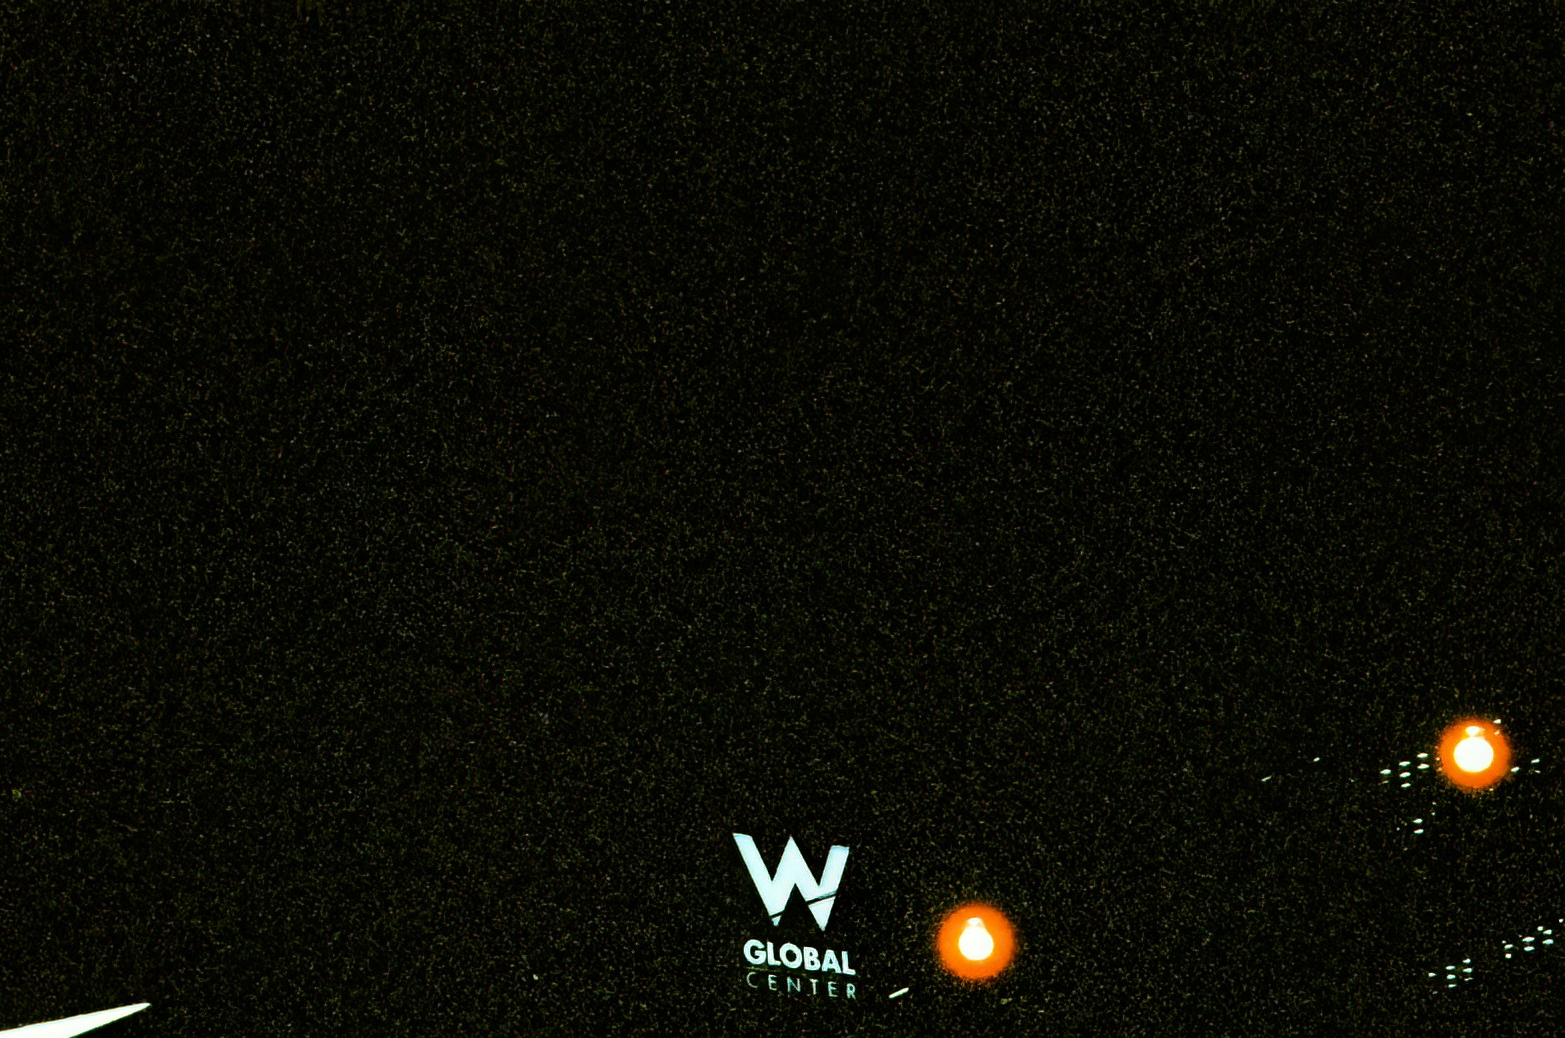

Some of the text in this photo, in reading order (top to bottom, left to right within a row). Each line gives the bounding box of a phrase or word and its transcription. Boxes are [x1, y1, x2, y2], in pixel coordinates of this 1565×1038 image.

[733, 833, 850, 932] W
[743, 939, 856, 975] GLOBAL
[746, 971, 856, 999] CENTER
